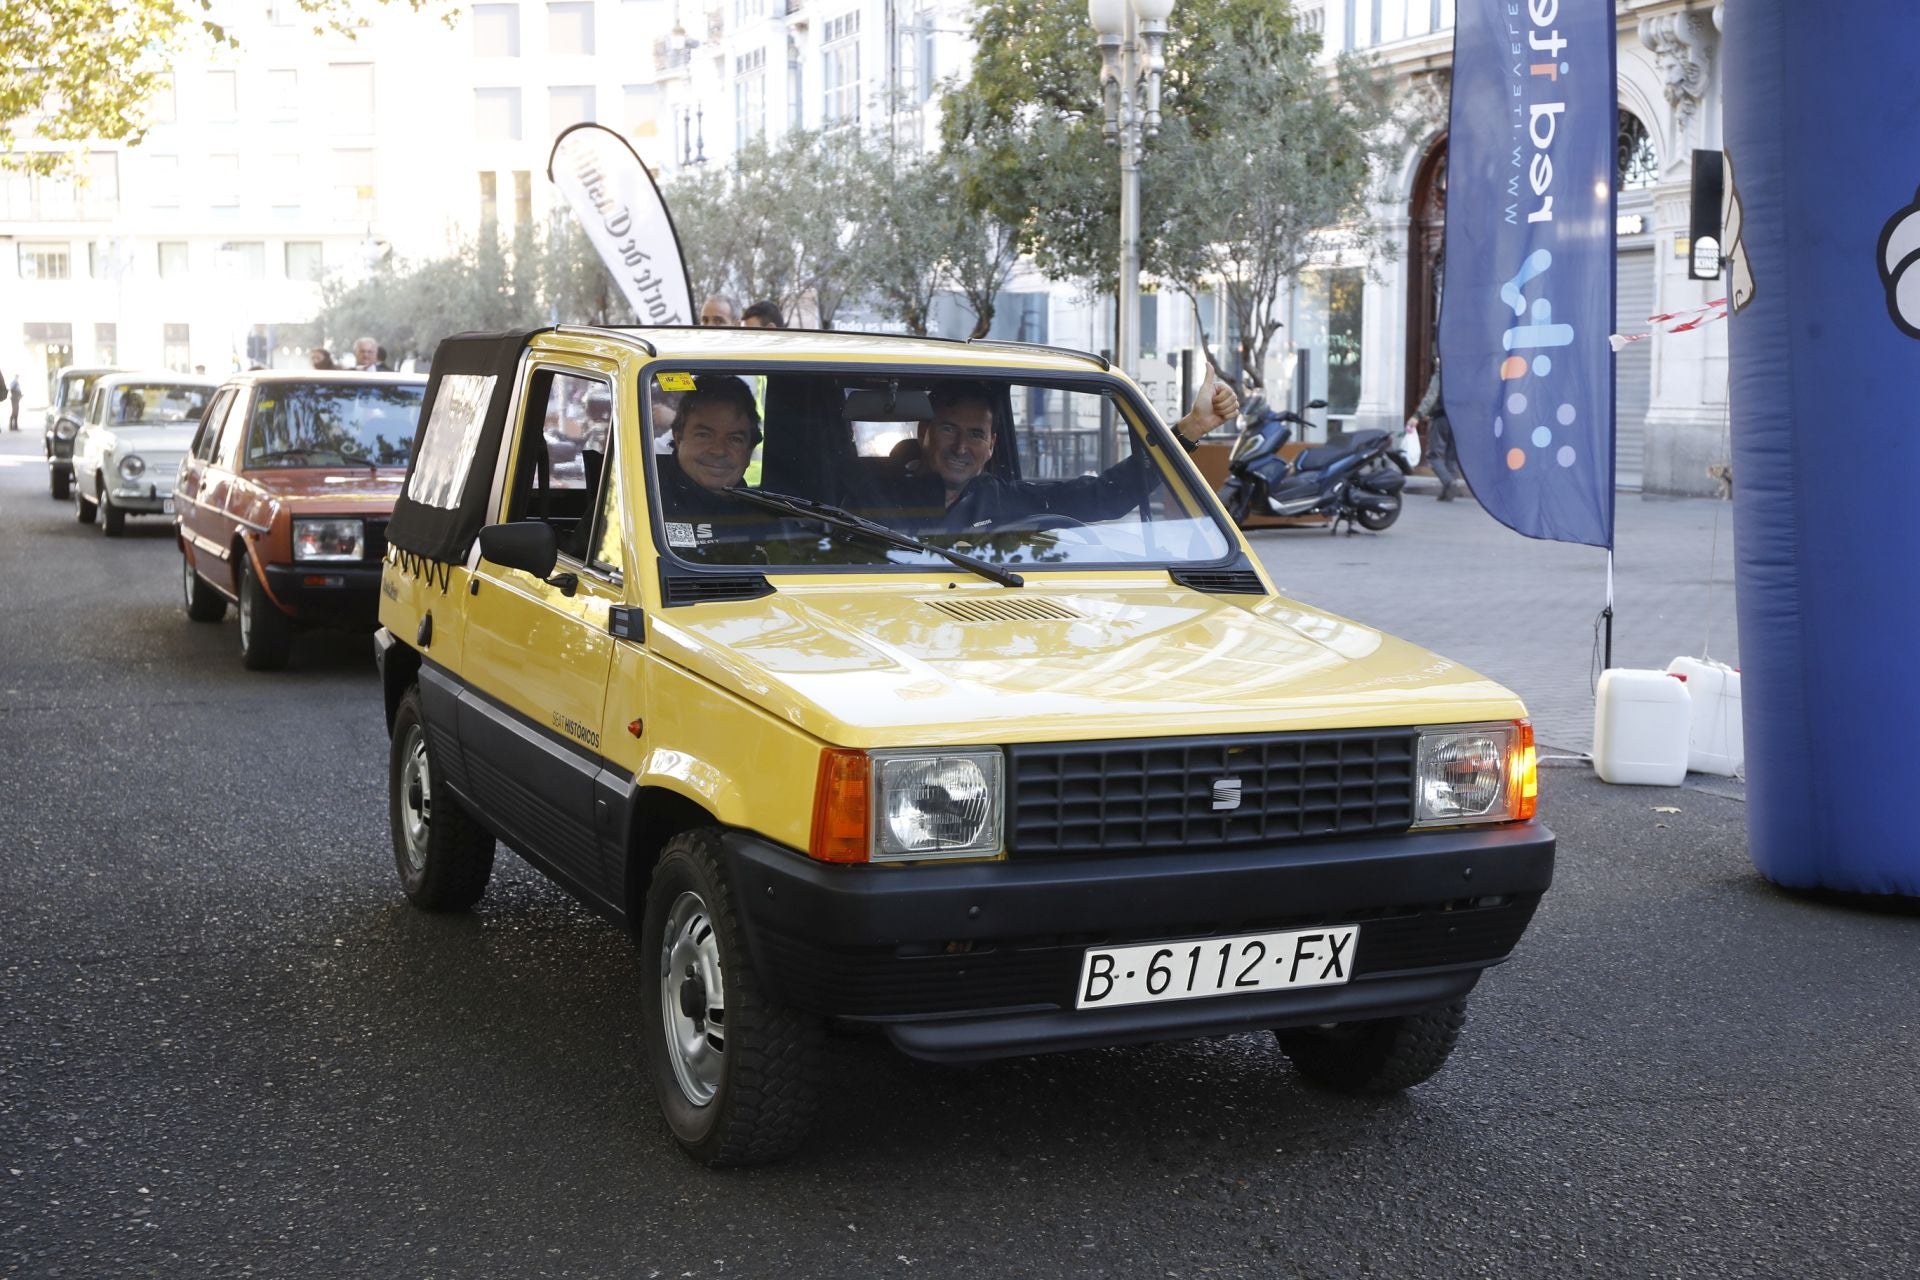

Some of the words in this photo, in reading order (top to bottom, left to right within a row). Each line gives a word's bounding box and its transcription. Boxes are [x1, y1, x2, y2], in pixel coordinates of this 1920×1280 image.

[834, 320, 863, 331] Todo
[865, 322, 879, 331] es
[552, 711, 565, 729] SEAT
